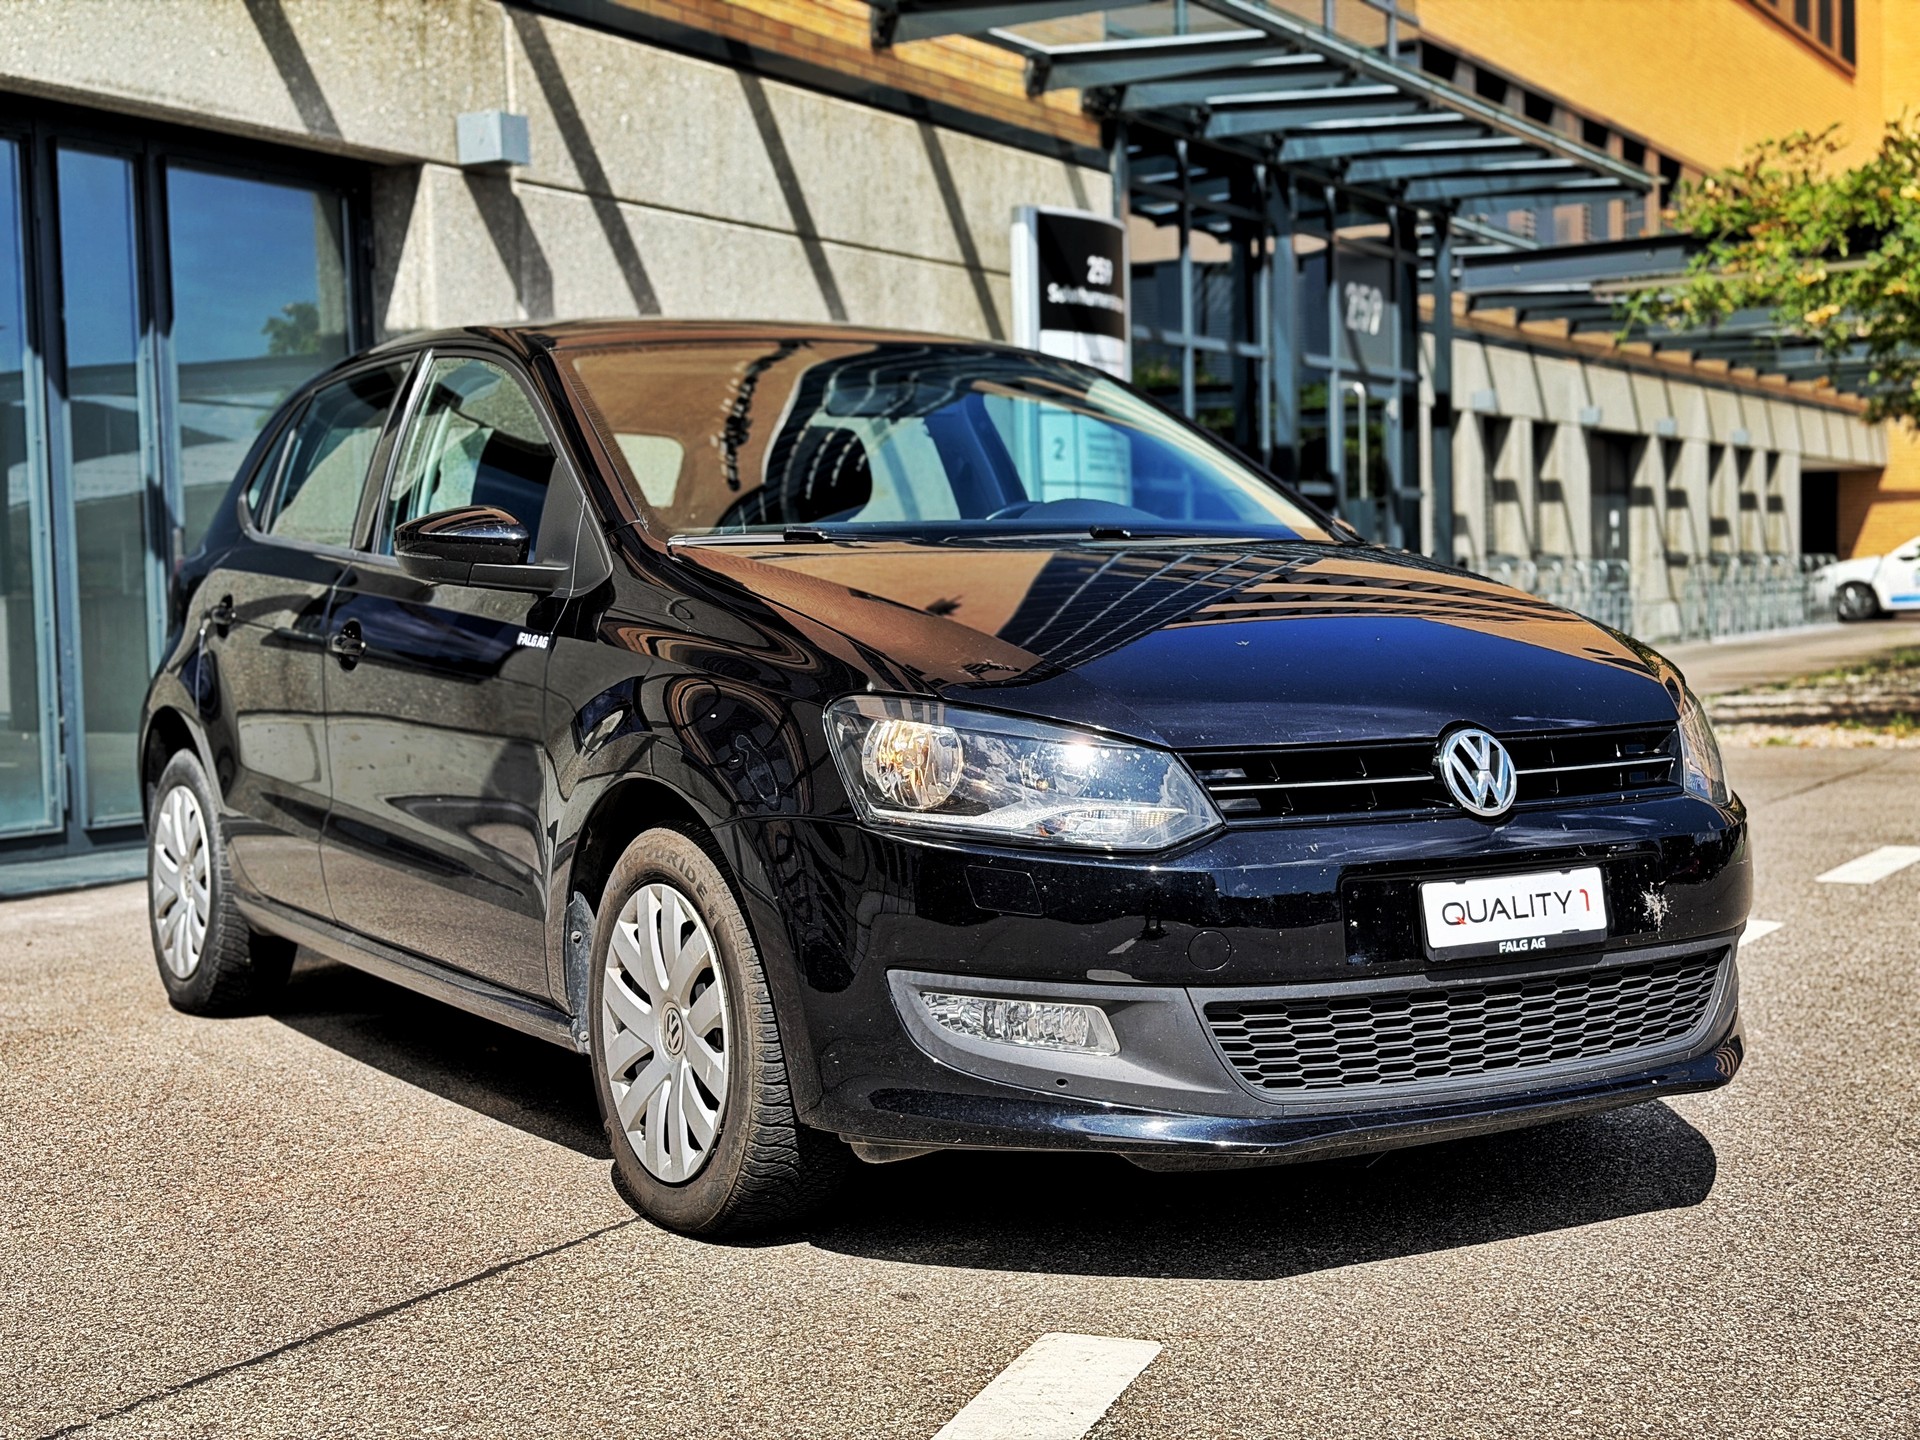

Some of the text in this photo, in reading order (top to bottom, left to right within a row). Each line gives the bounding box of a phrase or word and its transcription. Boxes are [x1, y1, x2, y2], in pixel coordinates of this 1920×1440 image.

[1345, 281, 1383, 336] 259
[1053, 437, 1066, 461] 2
[517, 631, 549, 649] FALG AG
[1442, 889, 1572, 926] QUALITY
[1499, 937, 1546, 954] FALG AG
